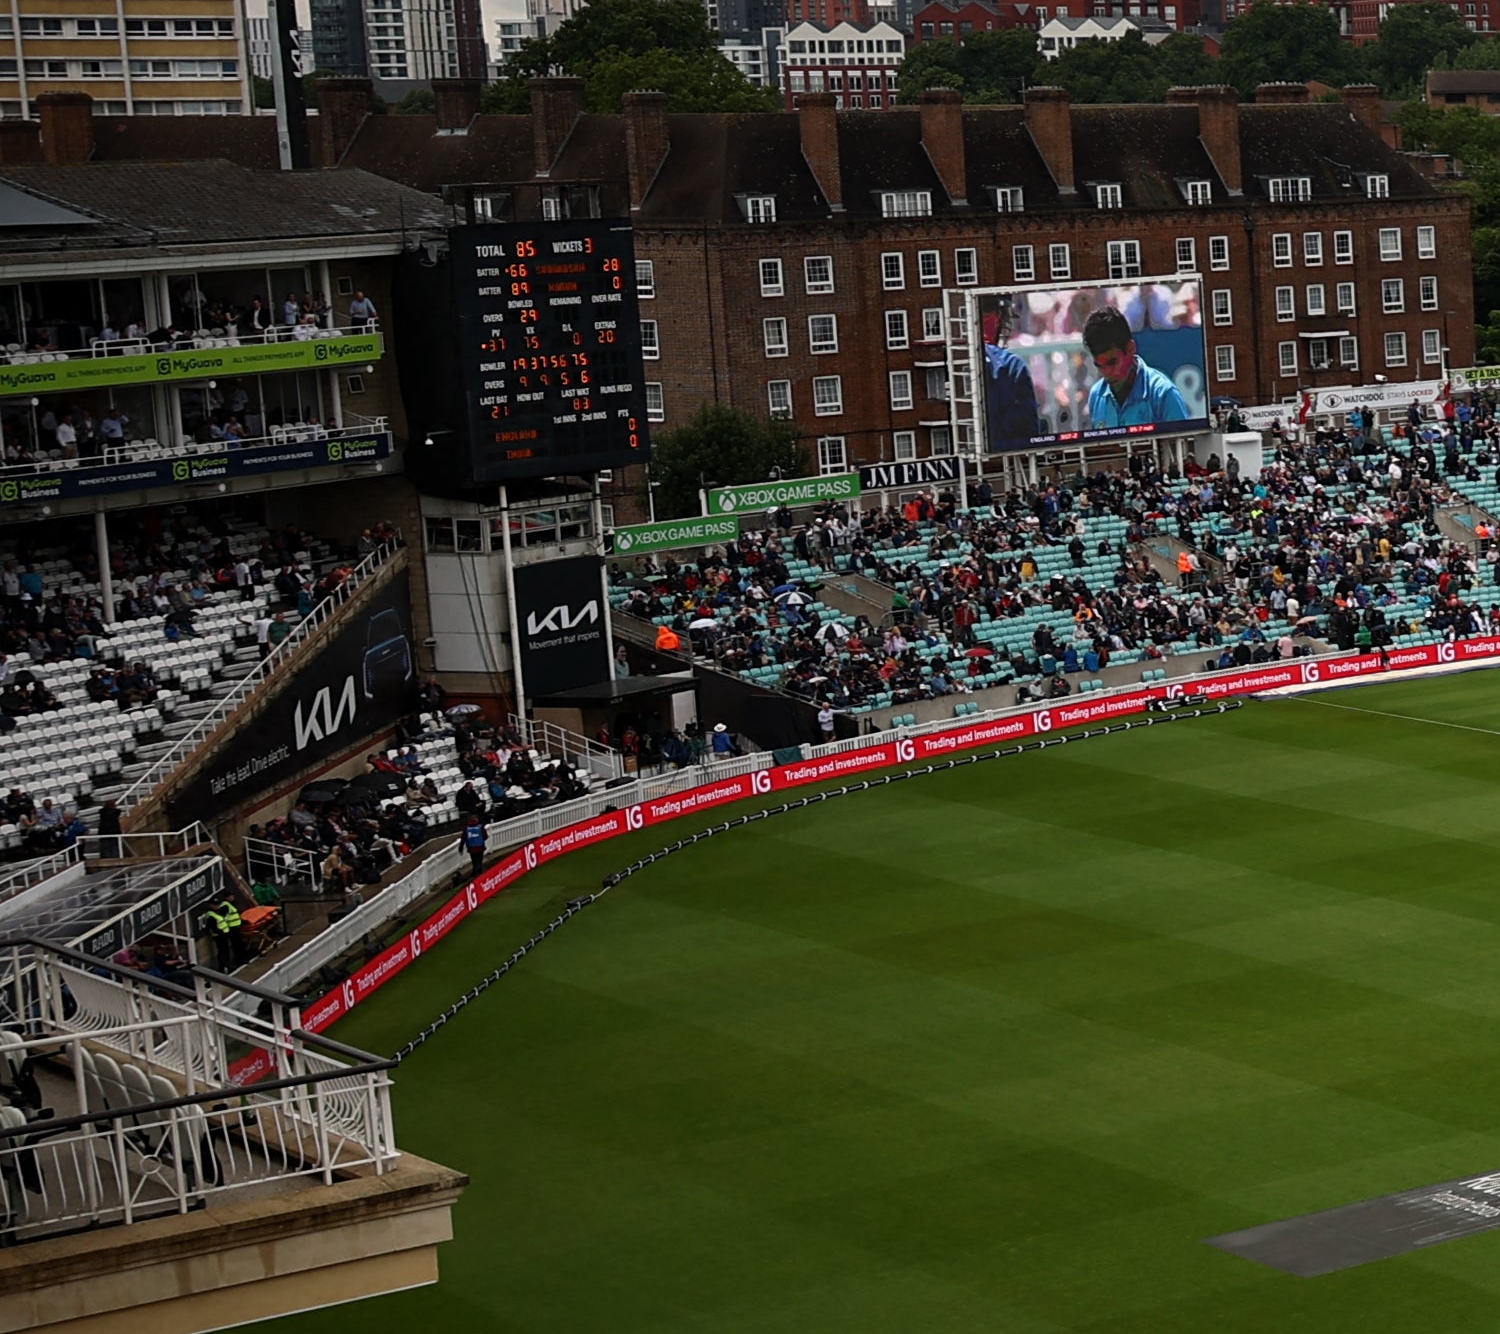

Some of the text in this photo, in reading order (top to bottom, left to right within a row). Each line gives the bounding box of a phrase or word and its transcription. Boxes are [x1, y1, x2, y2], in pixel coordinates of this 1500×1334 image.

[476, 241, 537, 258] TOTAL 85
[552, 238, 593, 253] WICKETS 3
[477, 268, 499, 277] BATTER
[603, 259, 619, 272] 28
[479, 276, 621, 296] BATTER 89 0
[483, 310, 537, 323] OVERS 29
[598, 330, 614, 343] 20
[329, 343, 373, 358] MyGuava
[172, 357, 223, 373] MyGuava
[480, 362, 506, 372] BOWLER
[513, 358, 526, 370] 19
[531, 356, 548, 369] 37
[572, 353, 587, 366] 75
[1344, 392, 1383, 404] WATCHDOG
[1407, 389, 1433, 399] LOCKED
[344, 438, 378, 452] MyGuava
[344, 448, 376, 459] Business
[191, 456, 228, 470] MyGuava
[192, 466, 226, 478] Business
[866, 459, 955, 489] JM FINN
[738, 480, 850, 507] XBOX GAME PASS
[635, 522, 735, 544] XBOX GAME PASS
[527, 599, 598, 636] KIA
[529, 630, 600, 651] Movement that inspires
[294, 675, 356, 751] KIA
[923, 721, 1023, 752] Trading and investments
[895, 738, 915, 762] IG
[140, 901, 162, 924] RADO
